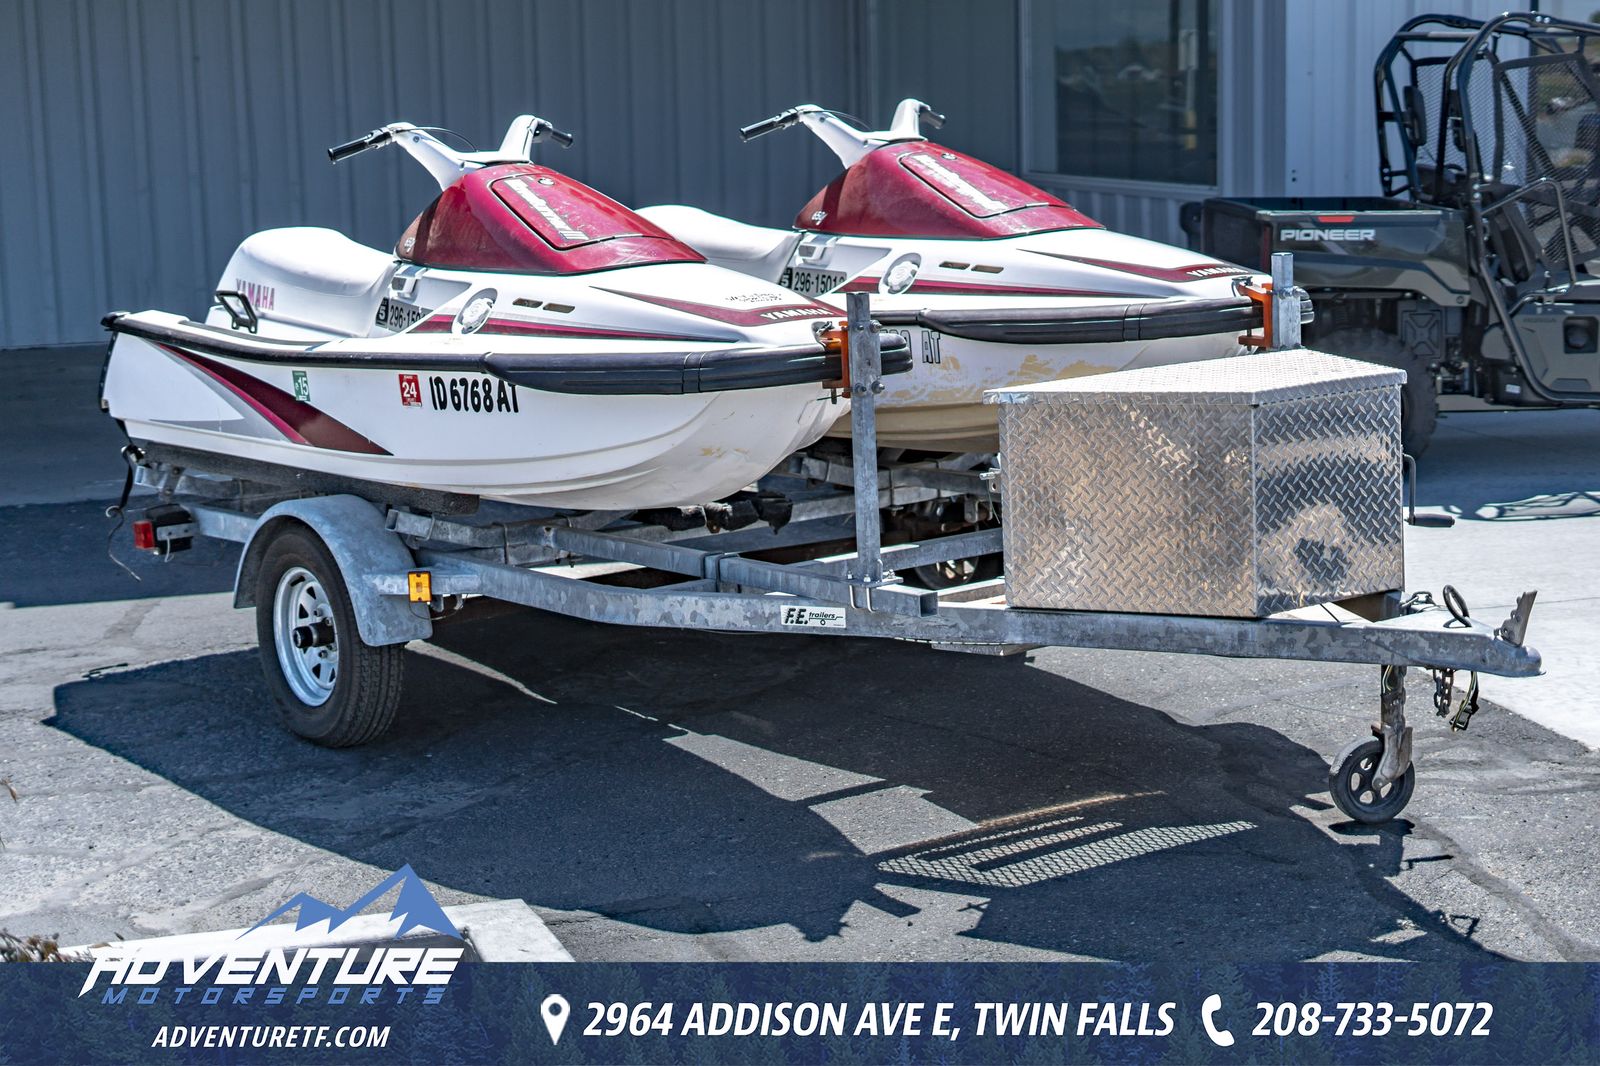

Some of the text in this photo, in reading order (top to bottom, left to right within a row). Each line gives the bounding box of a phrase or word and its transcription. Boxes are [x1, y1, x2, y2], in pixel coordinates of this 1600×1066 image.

[1280, 229, 1375, 241] PIONEER
[378, 305, 386, 320] 5
[760, 308, 834, 320] YAMAHA
[921, 330, 940, 364] AT
[297, 376, 309, 396] 15
[402, 381, 418, 398] 24
[429, 375, 519, 413] ID 6768 AT
[784, 607, 837, 625] F.E. trailers
